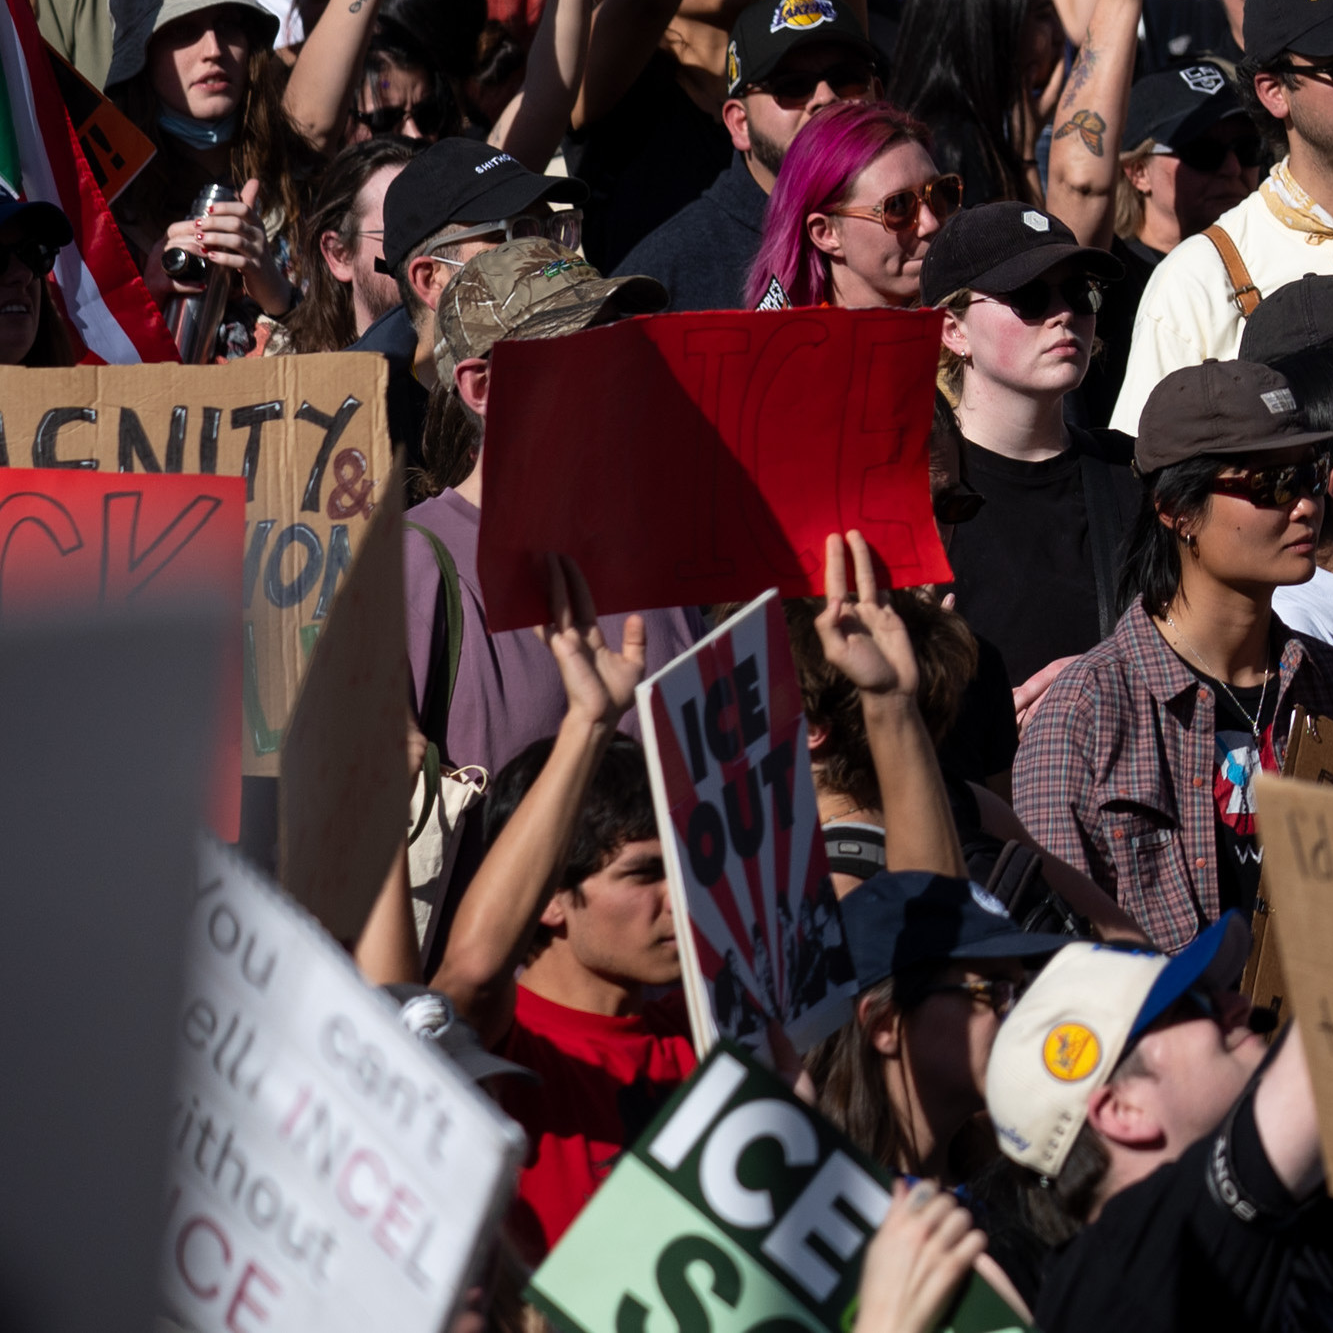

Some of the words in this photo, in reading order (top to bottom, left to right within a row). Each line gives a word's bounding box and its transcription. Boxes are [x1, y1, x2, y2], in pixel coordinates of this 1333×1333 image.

[474, 152, 520, 175] SHITHO
[326, 447, 380, 521] &
[675, 318, 931, 578] ICE
[680, 655, 767, 782] ICE
[687, 764, 796, 887] OUT
[199, 877, 277, 991] ou
[319, 1013, 455, 1163] can't
[170, 1186, 286, 1333] CE
[177, 1095, 338, 1284] ithout
[281, 1084, 436, 1289] INCEL
[648, 1051, 893, 1303] ICE
